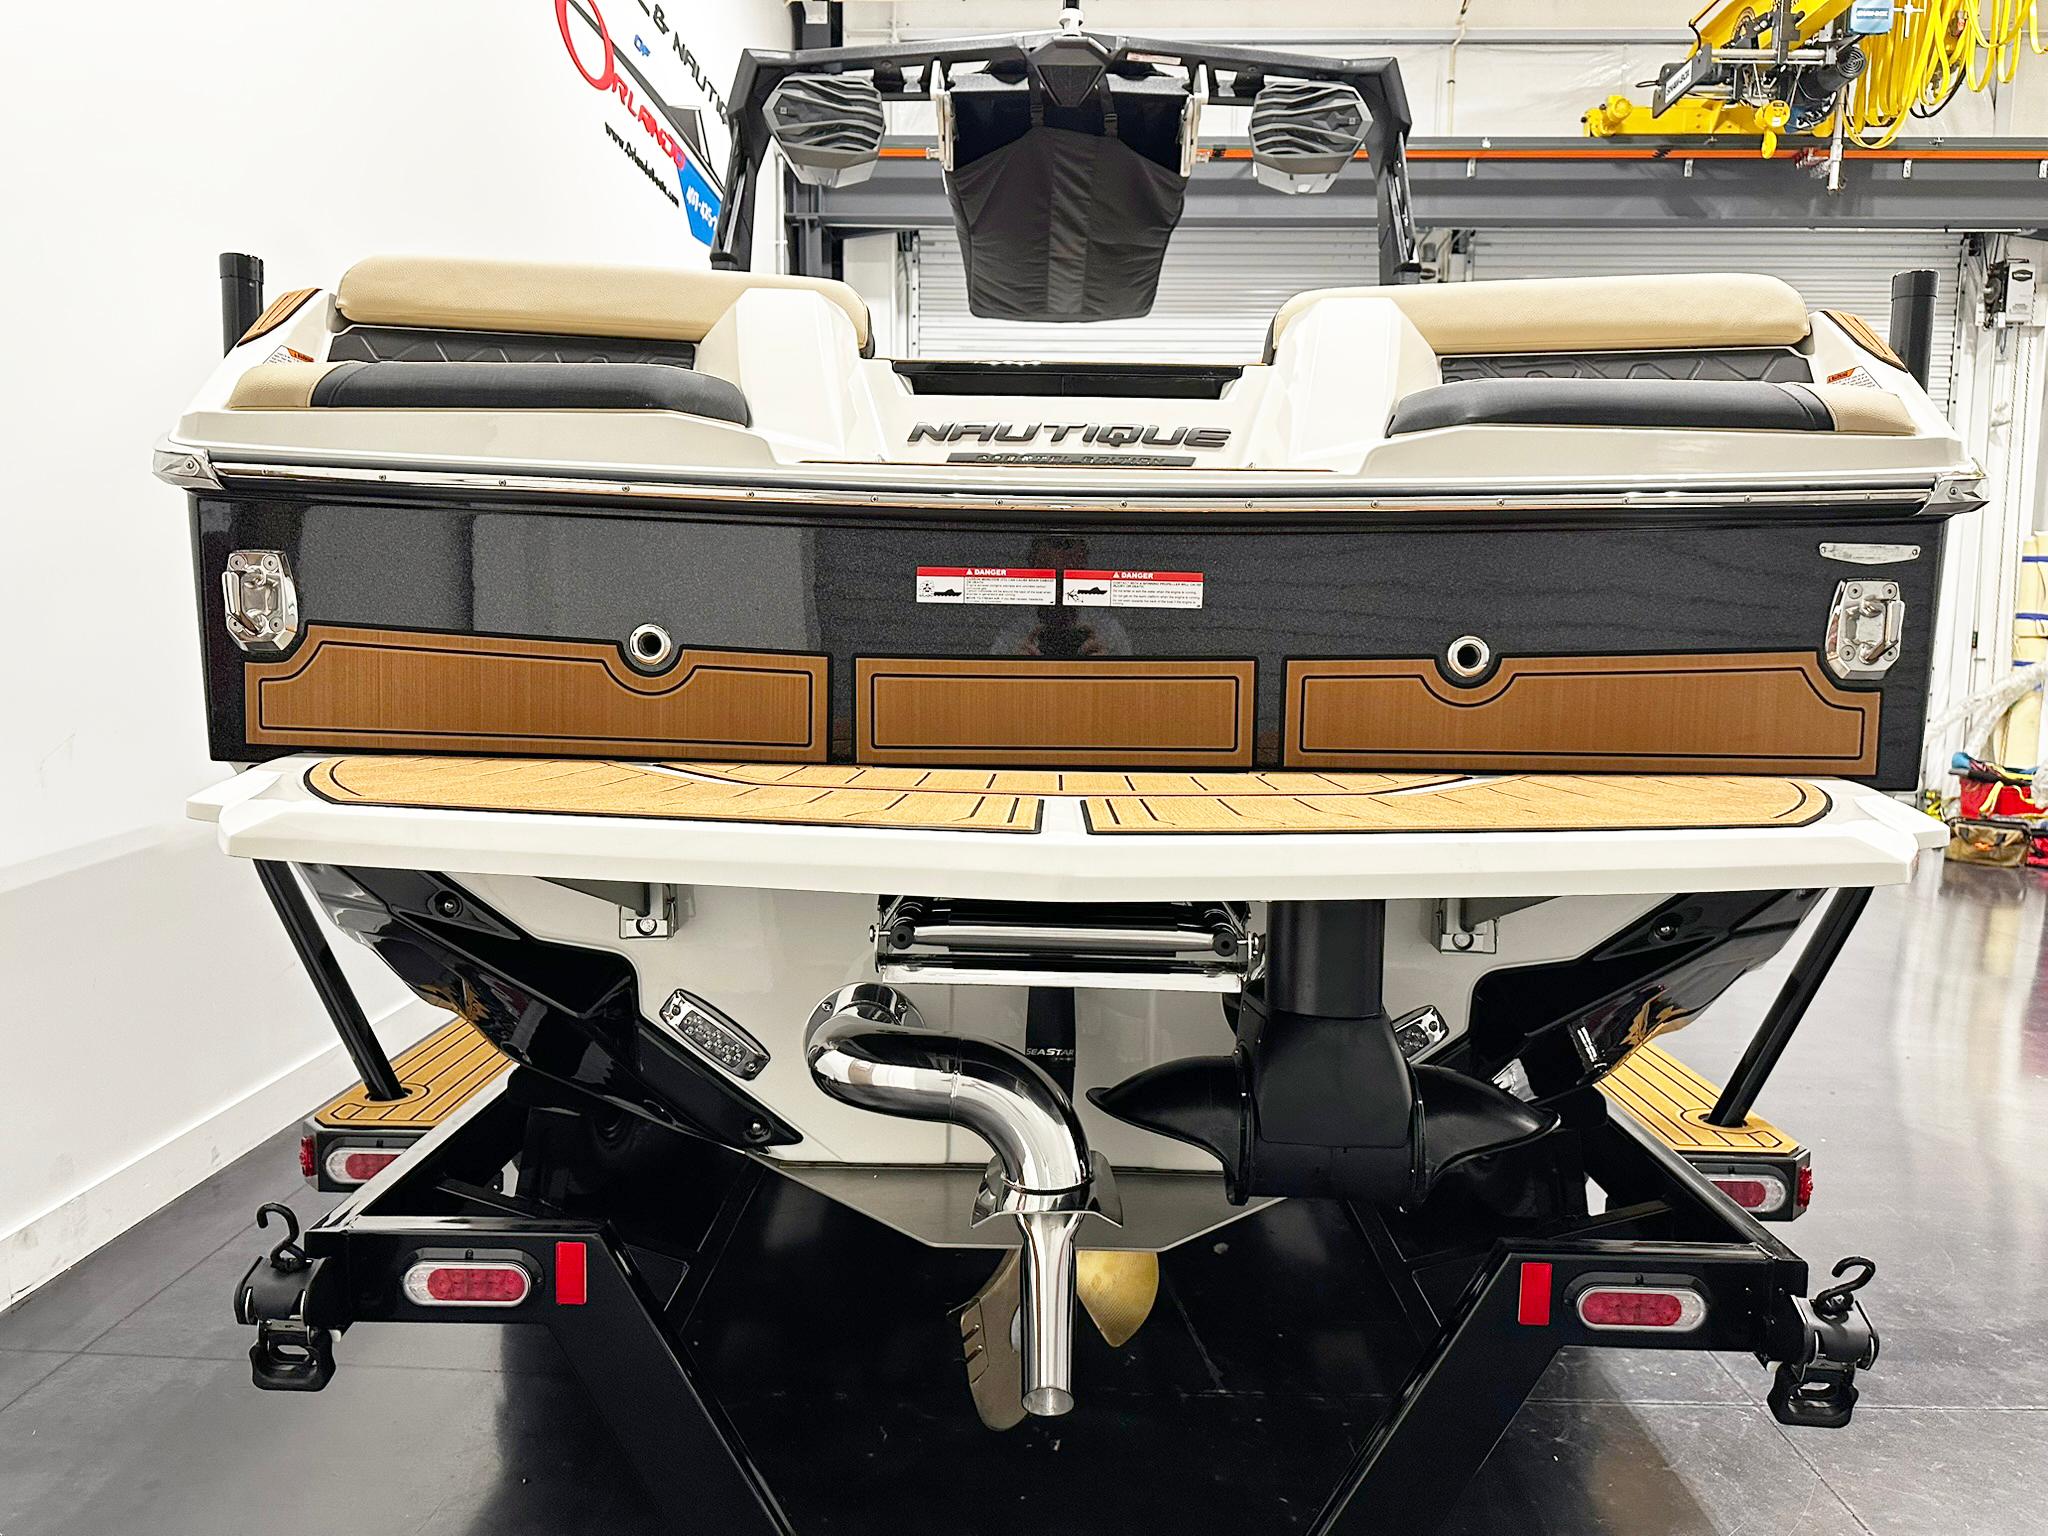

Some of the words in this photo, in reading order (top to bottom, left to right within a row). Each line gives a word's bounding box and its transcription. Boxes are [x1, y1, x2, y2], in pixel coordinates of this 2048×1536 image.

[653, 3, 670, 35] &
[555, 0, 687, 171] ORLANDO
[907, 421, 1231, 447] NAUTIQUE
[974, 568, 1007, 576] DANGER
[1121, 571, 1154, 579] DANGER
[1026, 1047, 1074, 1056] SEASTAR
